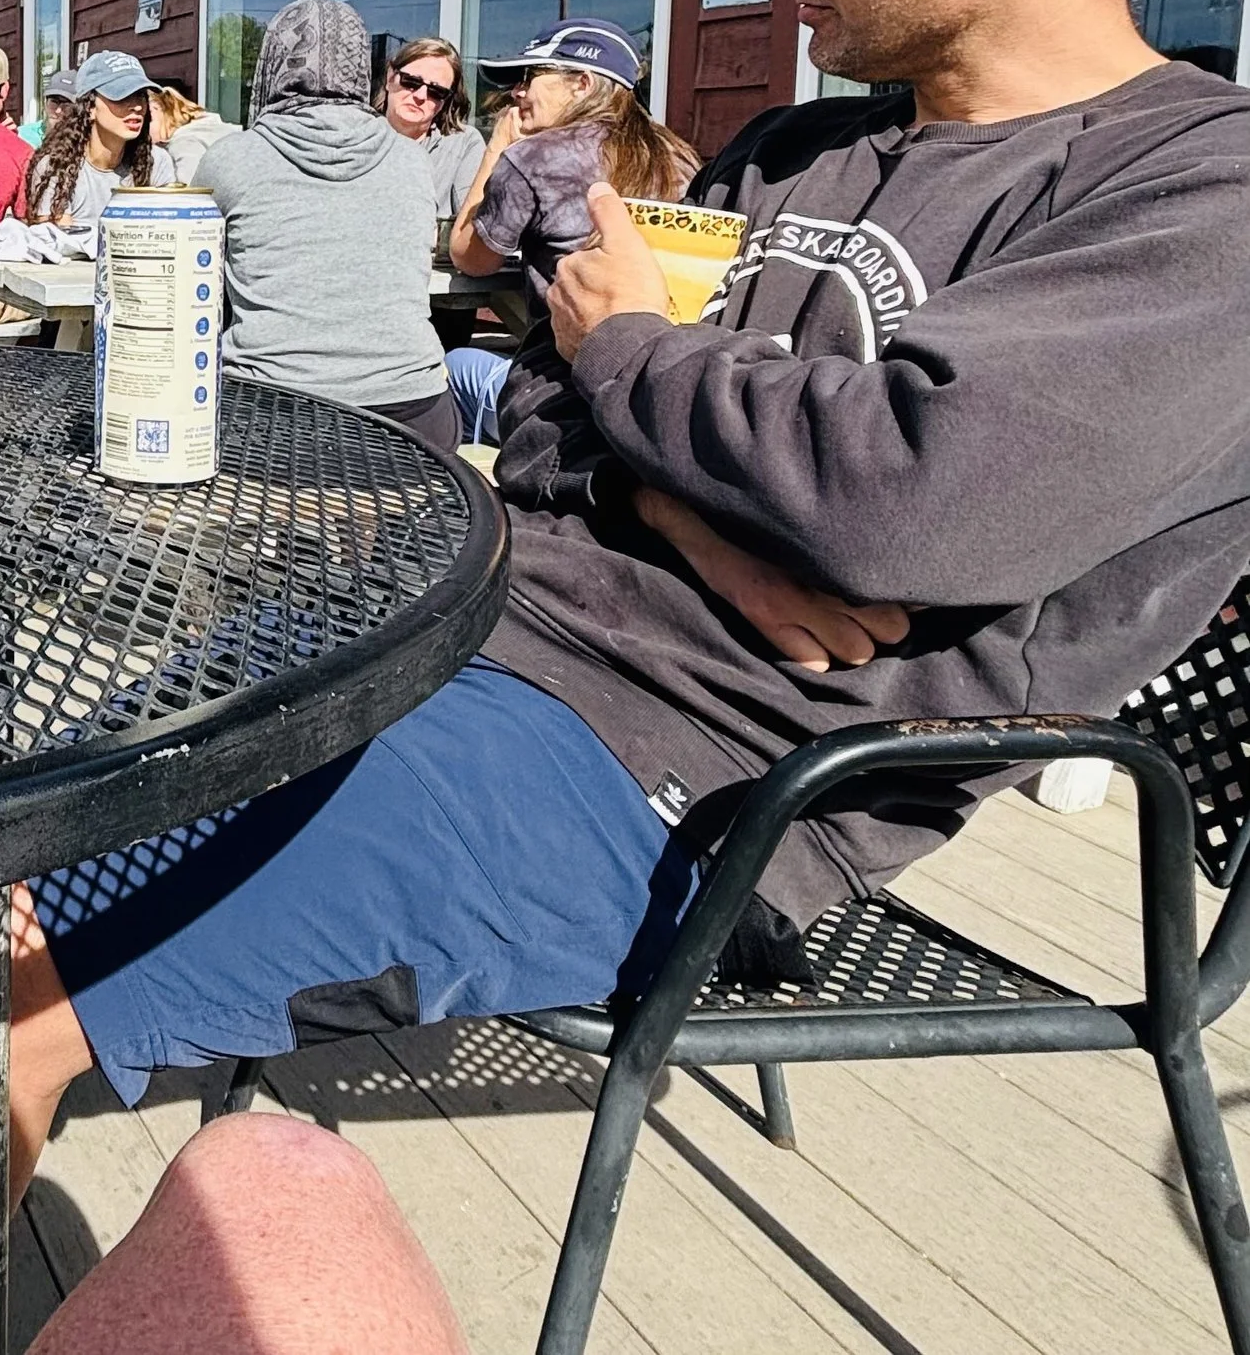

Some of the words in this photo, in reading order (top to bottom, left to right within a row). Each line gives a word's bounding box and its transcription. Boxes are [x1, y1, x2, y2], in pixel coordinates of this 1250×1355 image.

[574, 45, 602, 61] MAX
[110, 229, 144, 240] Nutrition
[148, 231, 175, 241] Facts
[111, 264, 137, 274] Calories
[161, 263, 175, 274] 10
